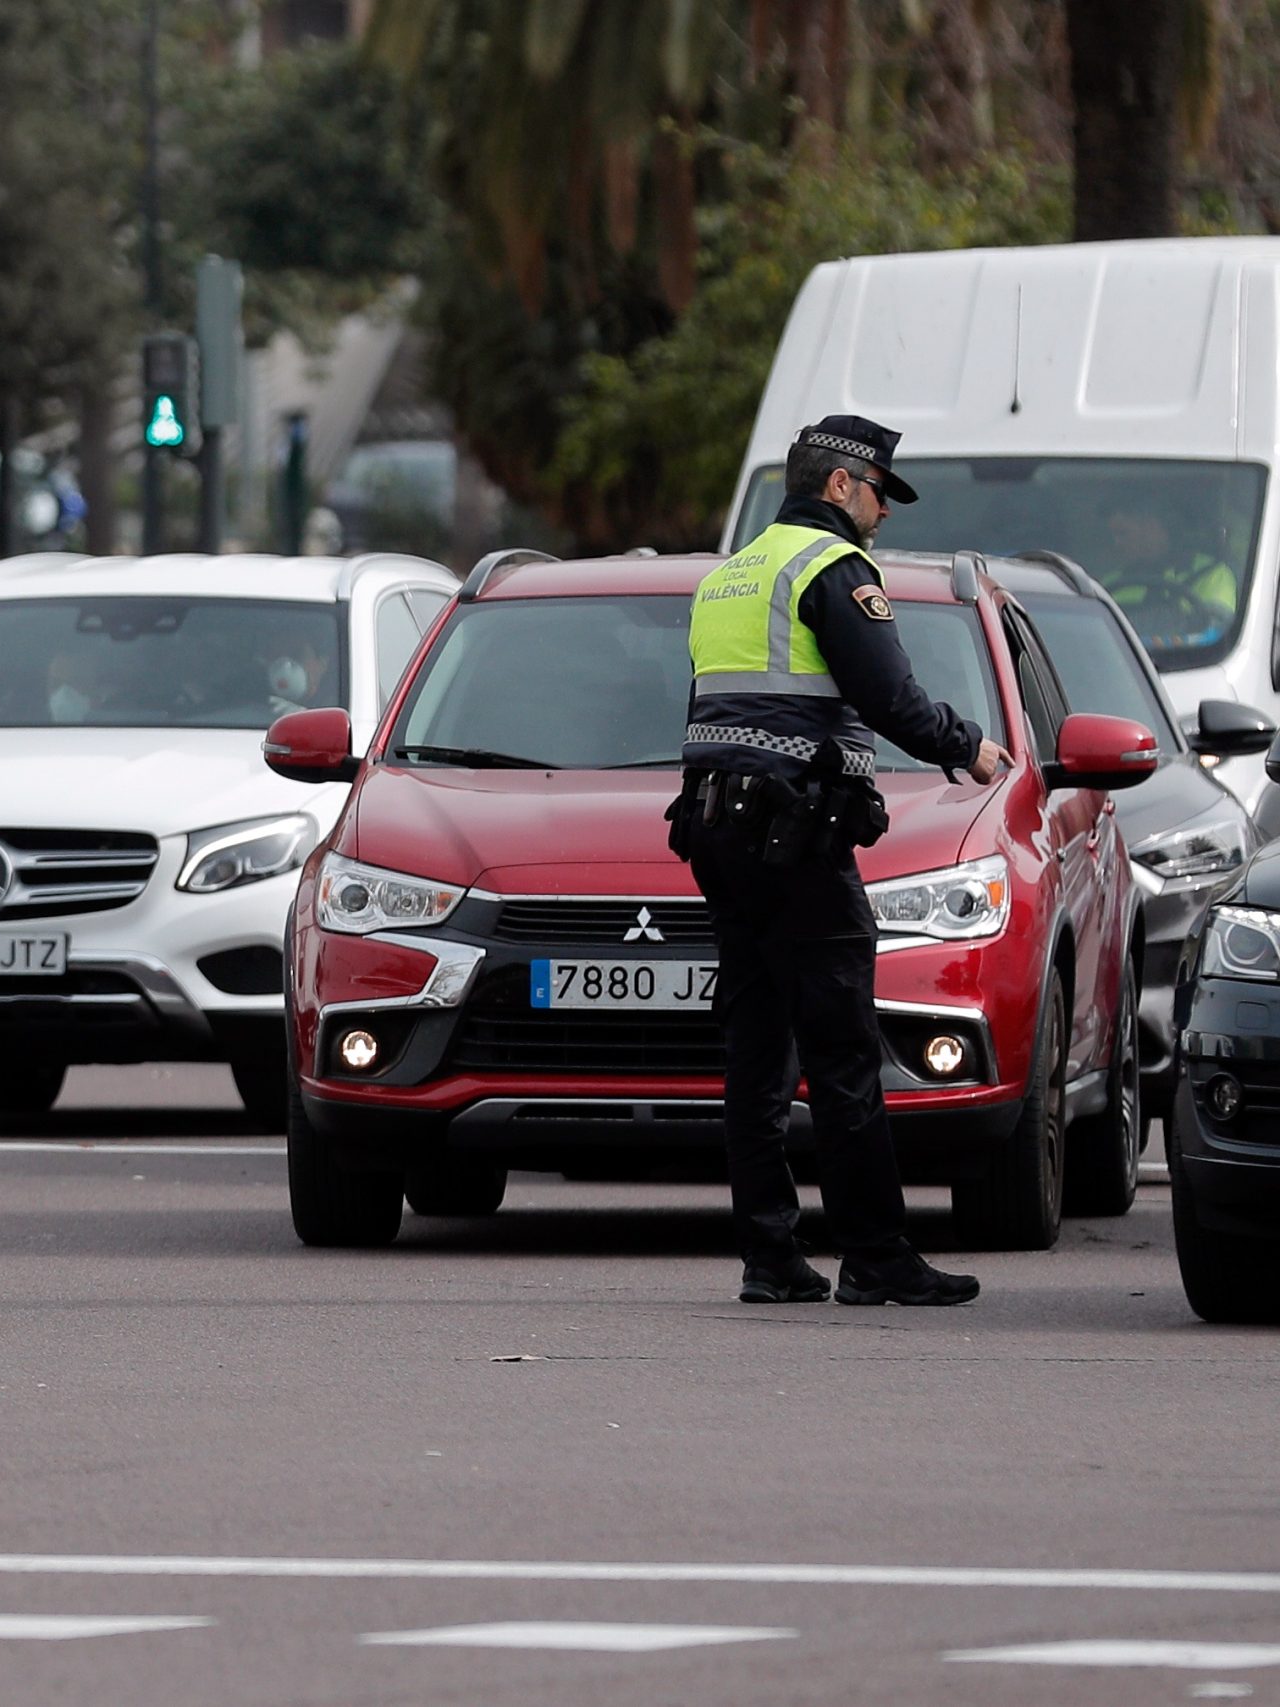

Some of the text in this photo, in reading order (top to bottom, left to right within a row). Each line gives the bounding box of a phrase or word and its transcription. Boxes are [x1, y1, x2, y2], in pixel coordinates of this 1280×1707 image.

[720, 554, 768, 571] POLICIA
[723, 571, 748, 581] LOCAL
[0, 939, 58, 968] JTZ
[536, 965, 719, 1001] E 7880 JZ
